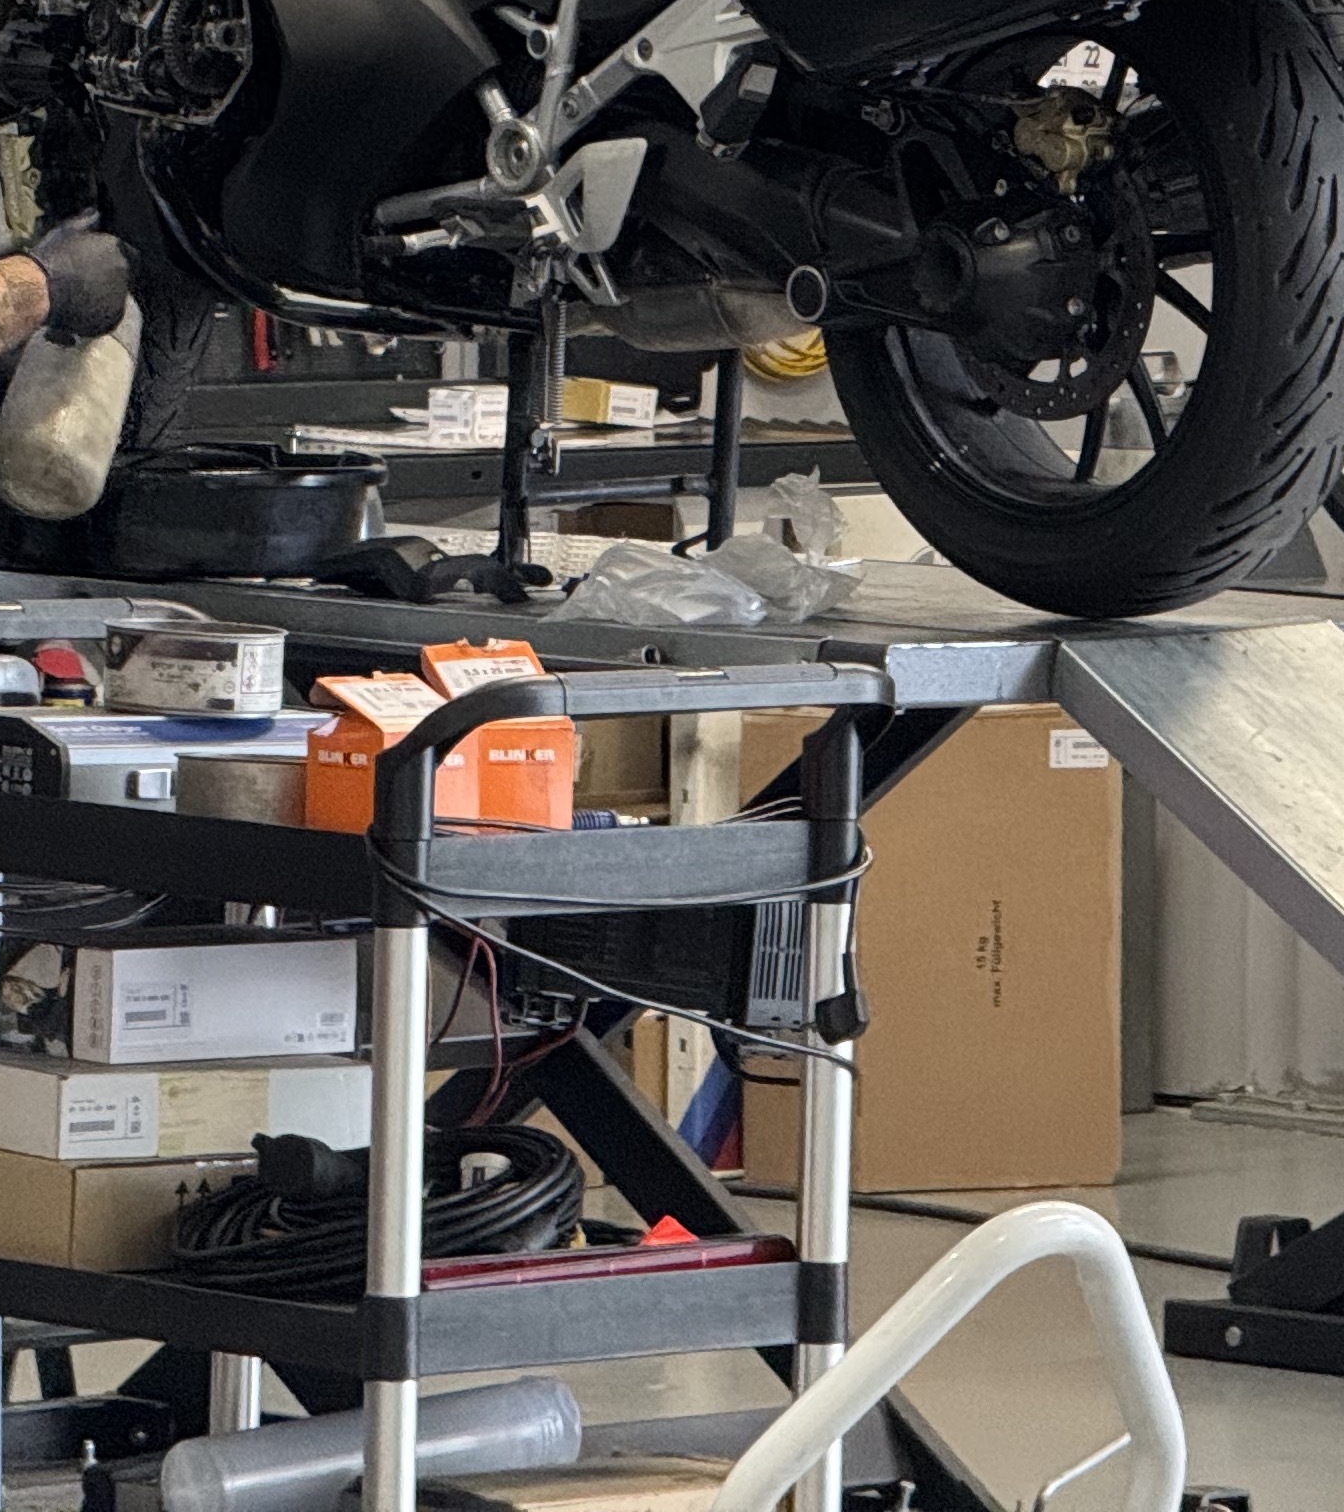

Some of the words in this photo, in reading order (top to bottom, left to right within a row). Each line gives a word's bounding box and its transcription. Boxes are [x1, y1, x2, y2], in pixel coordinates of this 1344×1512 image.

[1083, 45, 1100, 68] 22
[316, 748, 369, 767] BLINKER
[488, 748, 556, 763] BLINKER
